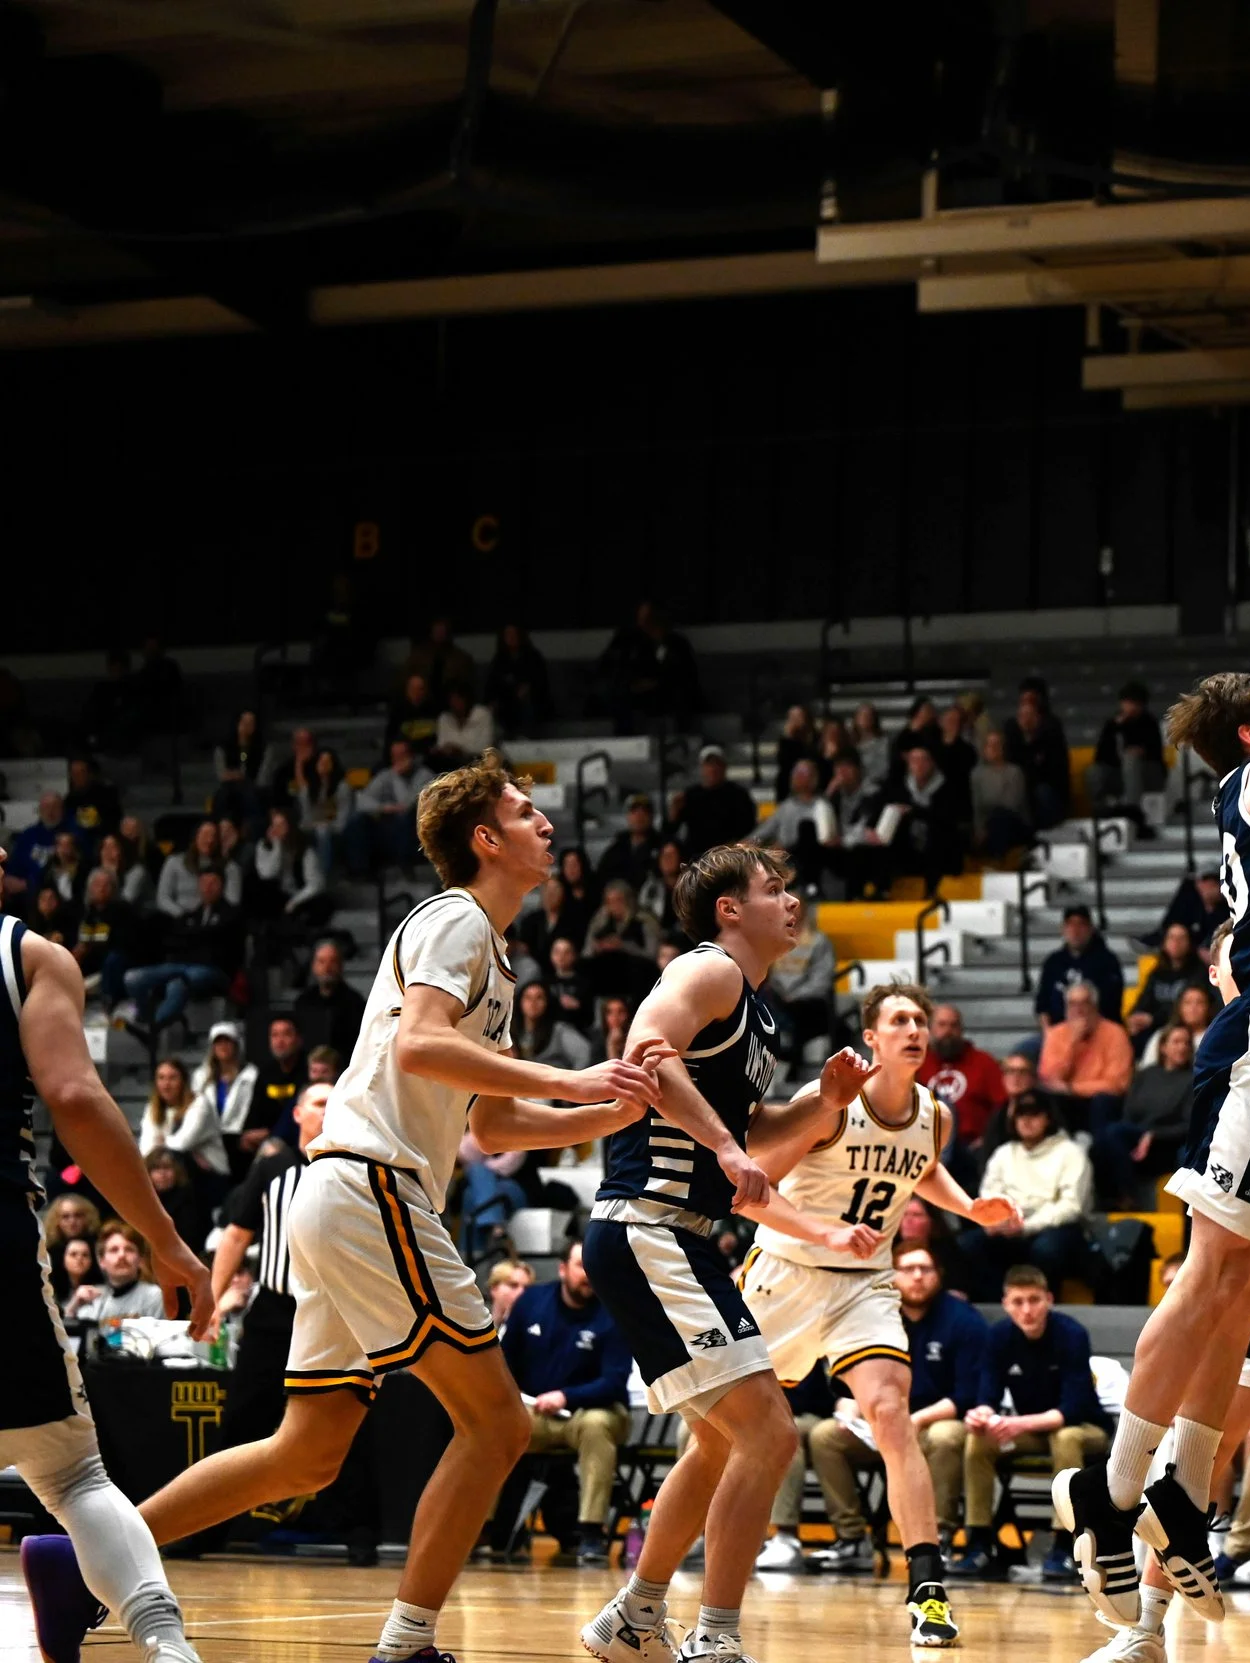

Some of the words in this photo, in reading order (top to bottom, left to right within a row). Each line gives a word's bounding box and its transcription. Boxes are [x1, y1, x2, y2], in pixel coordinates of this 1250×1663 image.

[353, 519, 382, 560] B
[470, 512, 502, 553] C
[846, 1145, 927, 1179] TITANS
[840, 1178, 897, 1231] 12
[737, 1324, 756, 1334] adidas
